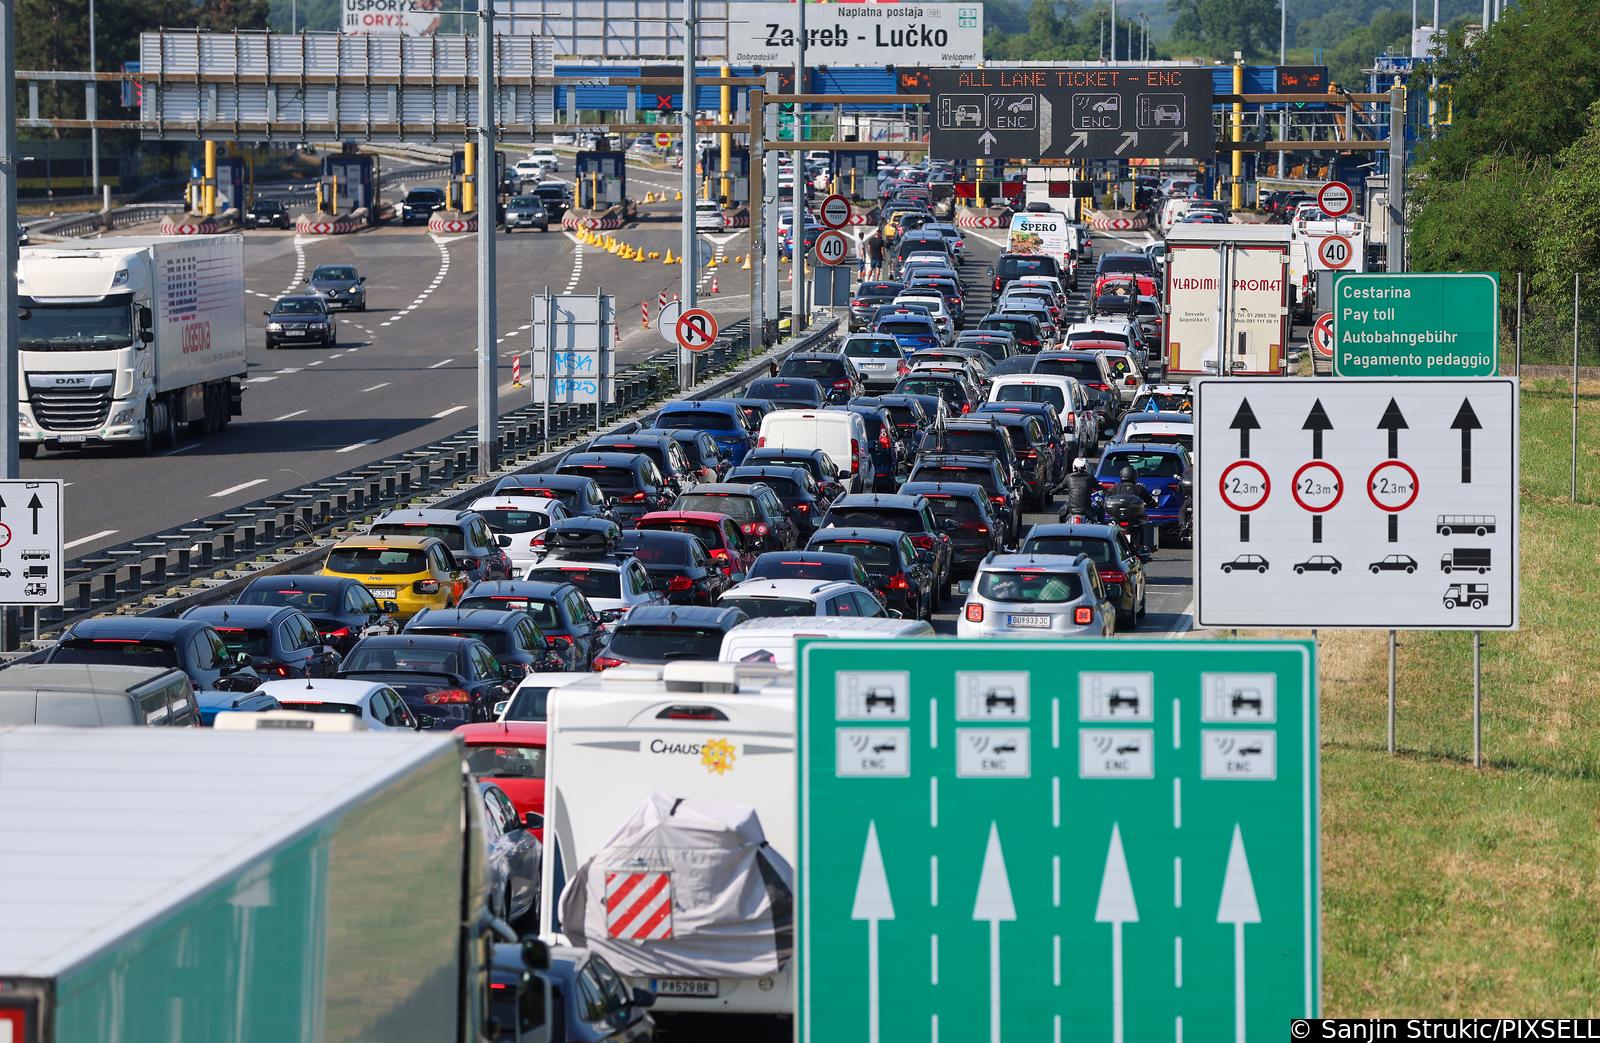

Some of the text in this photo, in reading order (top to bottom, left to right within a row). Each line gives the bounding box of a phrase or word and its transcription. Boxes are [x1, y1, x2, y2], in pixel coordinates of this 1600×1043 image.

[838, 6, 923, 18] Naplatna postaja
[347, 14, 359, 26] ili
[875, 24, 948, 47] Lučko
[959, 73, 993, 86] ALL
[1001, 73, 1047, 86] LANE
[1056, 72, 1119, 86] TICKET
[1148, 72, 1181, 86] ENC
[997, 117, 1026, 128] ENC
[1082, 117, 1111, 128] ENC
[1021, 221, 1057, 231] ŠPERO
[823, 240, 841, 256] 40
[1326, 244, 1345, 260] 40
[1173, 278, 1220, 290] VLADIMI
[1343, 286, 1411, 299] Cestarina
[1343, 308, 1395, 323] Pay toll
[1343, 330, 1458, 346] Autobahngebühr
[1343, 352, 1490, 368] Pagamento pedaggio
[861, 759, 885, 769] ENC
[982, 760, 1006, 770] ENC
[1106, 761, 1130, 771] ENC
[1227, 763, 1251, 773] ENC
